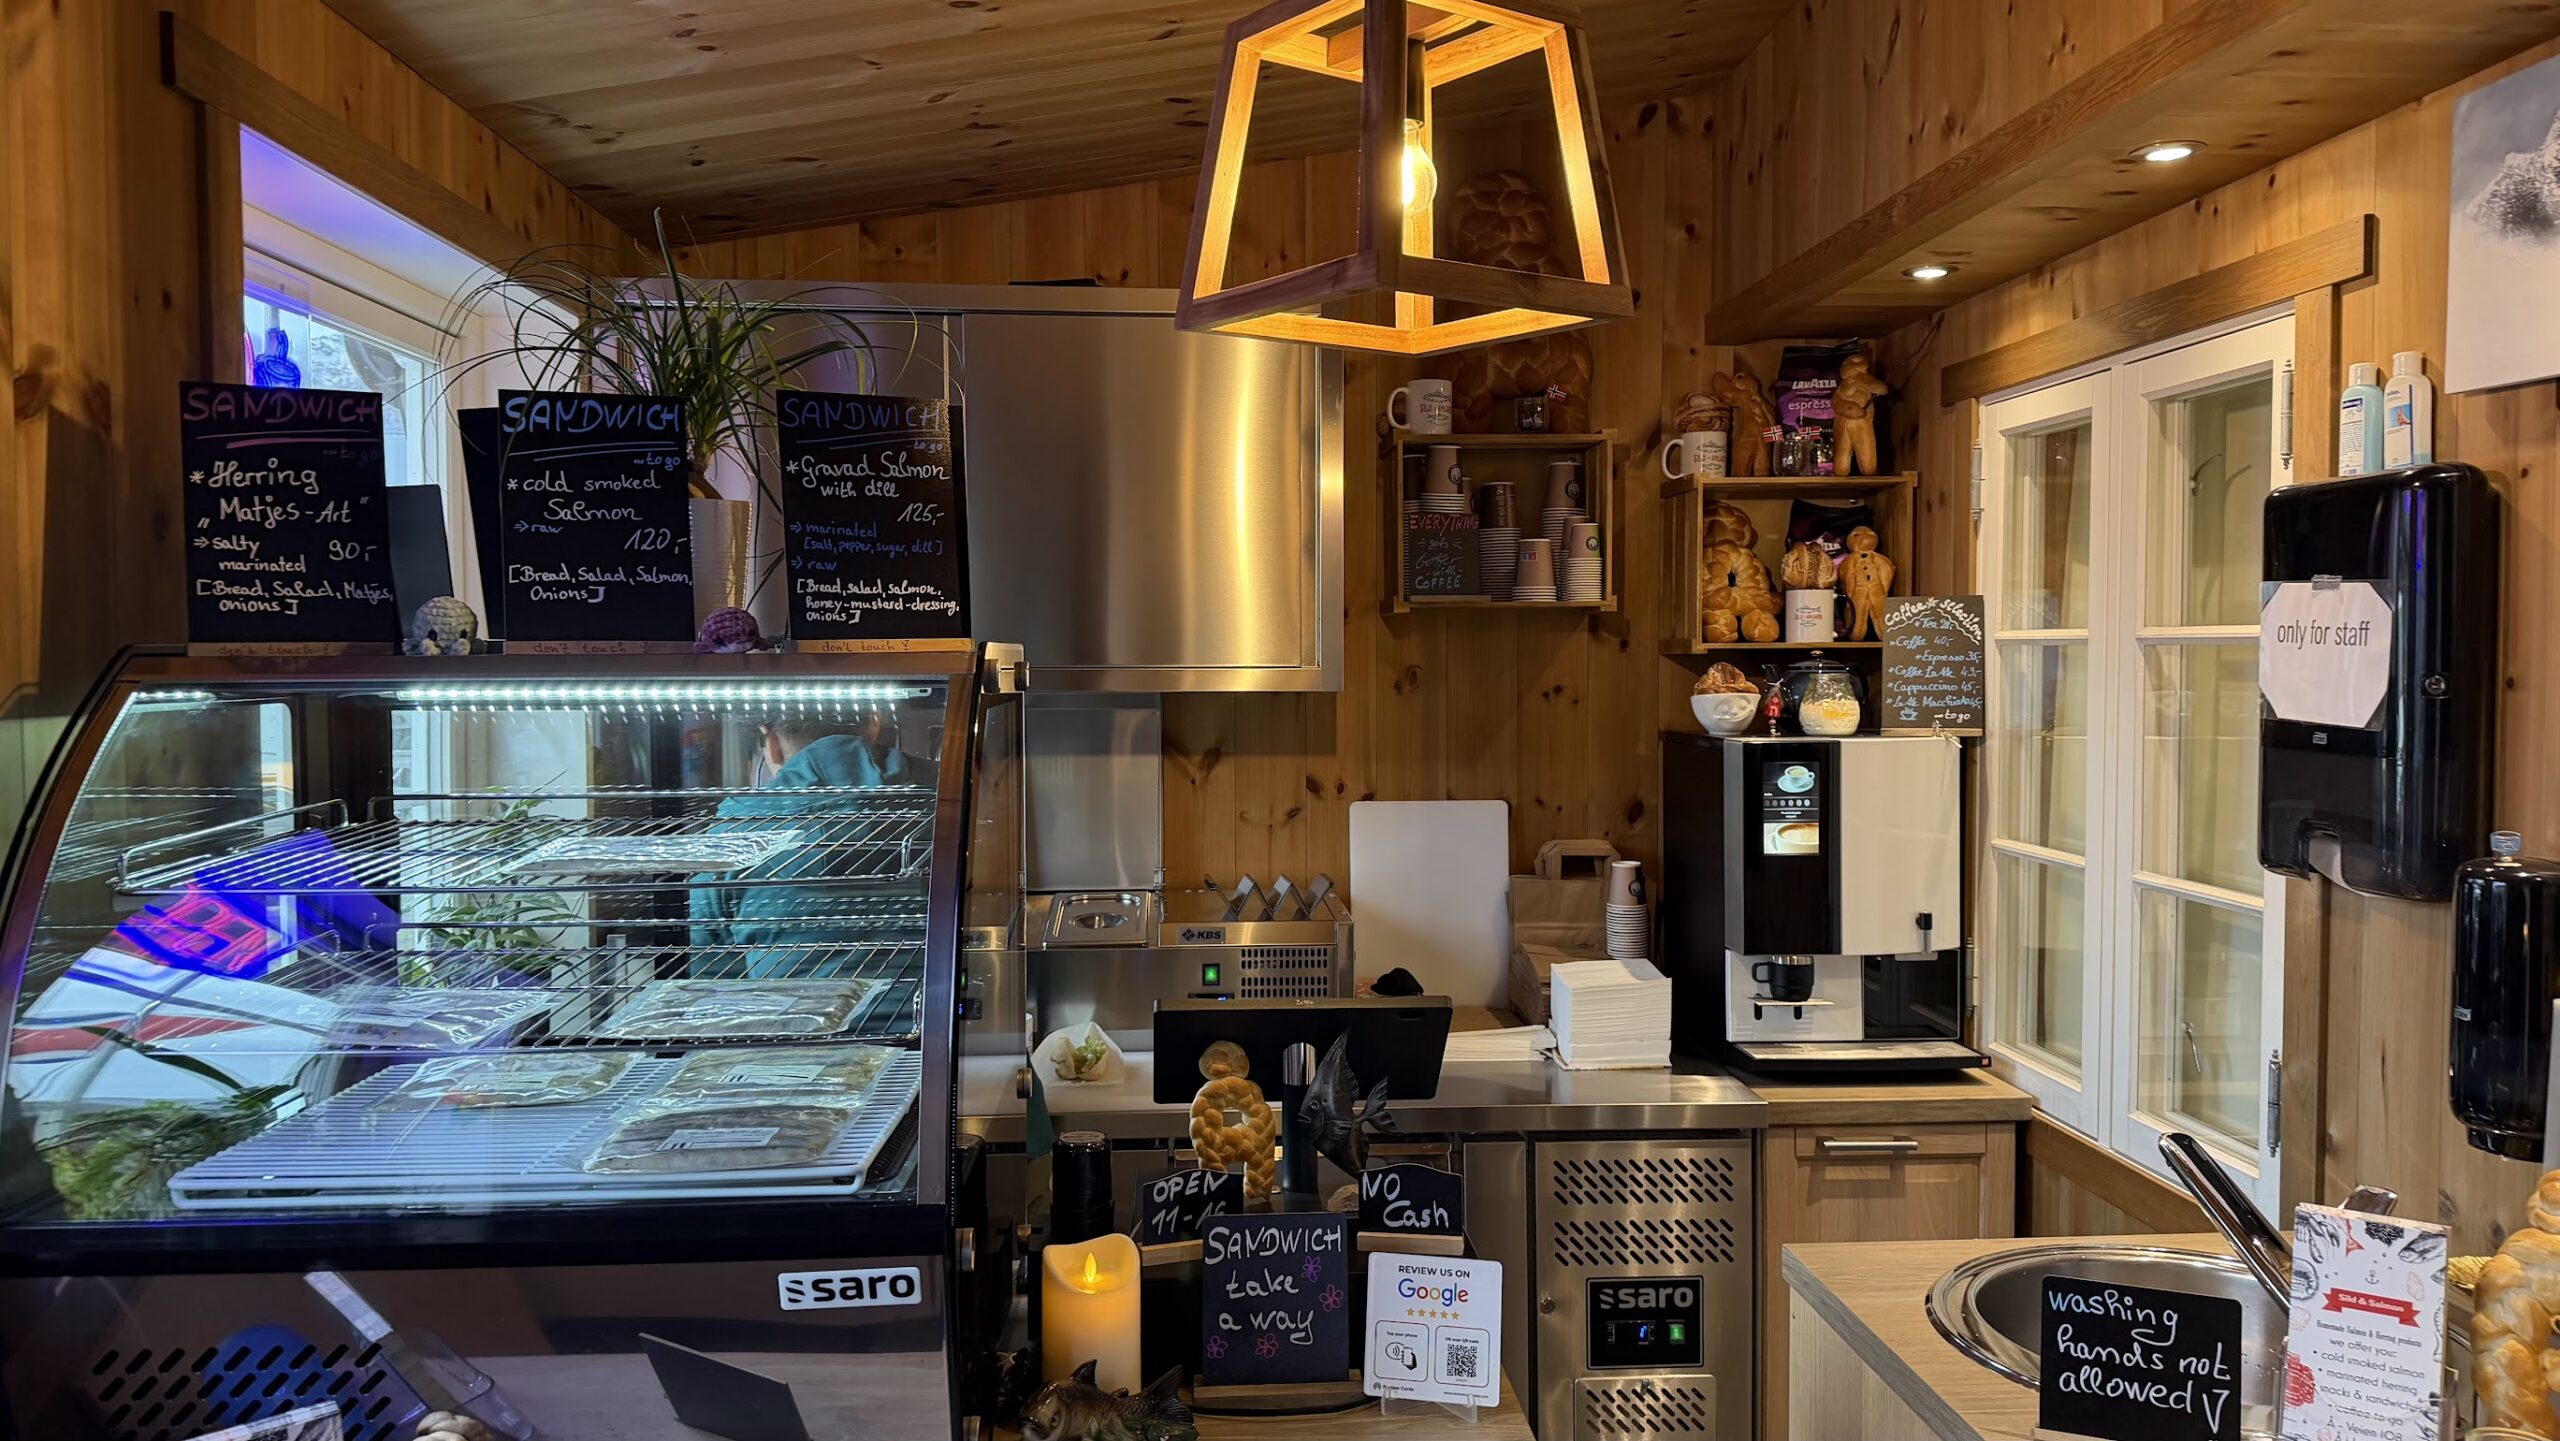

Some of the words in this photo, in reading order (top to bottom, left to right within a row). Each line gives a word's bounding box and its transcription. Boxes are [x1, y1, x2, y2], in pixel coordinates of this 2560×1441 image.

[1792, 379, 1837, 389] LAVAZZA
[183, 387, 379, 424] SANDWICH
[503, 396, 680, 433] SANDWICH
[779, 398, 942, 432] SANDWICH
[1788, 400, 1832, 412] espress
[208, 457, 320, 495] Herring
[523, 470, 574, 493] cold
[584, 469, 661, 490] smoked
[801, 454, 876, 488] Gravad
[880, 451, 951, 480] Salmon
[820, 481, 857, 497] with
[864, 480, 900, 498] dill
[543, 498, 643, 522] Salmon
[531, 523, 564, 534] raw
[805, 521, 878, 538] marinated
[1409, 513, 1479, 536] EVERYTHING
[212, 535, 260, 558] salty
[219, 553, 307, 573] marinated
[807, 560, 838, 571] raw
[1433, 565, 1456, 576] with
[1885, 602, 1926, 626] Coffee
[1920, 618, 1937, 629] Tea
[822, 640, 853, 652] don't
[861, 640, 896, 652] touch
[2277, 619, 2307, 650] only
[2310, 619, 2331, 645] for
[2335, 621, 2370, 647] staff
[533, 642, 568, 653] don't
[582, 642, 626, 653] touch
[1922, 651, 1964, 665] Espresso
[1925, 666, 1955, 678] Latte
[1894, 681, 1958, 695] Cappuccino
[1893, 696, 1919, 707] Latte
[1197, 931, 1222, 940] KBS
[1153, 1171, 1228, 1203] OPEN
[1361, 1172, 1401, 1201] NO
[1383, 1200, 1449, 1229] Cash
[1204, 1224, 1342, 1265] SANDWICH
[1225, 1267, 1300, 1299] take
[1398, 1265, 1438, 1276] REVIEW
[1440, 1269, 1453, 1277] US
[1456, 1270, 1470, 1278] ON
[811, 1274, 915, 1303] saro
[1398, 1278, 1469, 1307] Google
[1618, 1286, 1694, 1309] saro
[2358, 1297, 2367, 1305] &
[2368, 1299, 2404, 1312] Salmon
[2049, 1289, 2178, 1346] washing
[2057, 1324, 2164, 1370] hands
[2179, 1342, 2231, 1380] not
[2330, 1339, 2345, 1348] we
[2348, 1341, 2373, 1353] offer
[2321, 1352, 2344, 1363] cold
[2347, 1357, 2386, 1371] smoked
[2389, 1365, 2425, 1379] salmon
[2059, 1365, 2194, 1413] allowed
[2320, 1385, 2350, 1398] snacks
[2353, 1389, 2362, 1400] &
[2326, 1369, 2379, 1387] marinated
[2382, 1380, 2418, 1396] herring
[2327, 1415, 2335, 1428] Å
[2346, 1421, 2377, 1437] Veien
[2387, 1416, 2404, 1427] go
